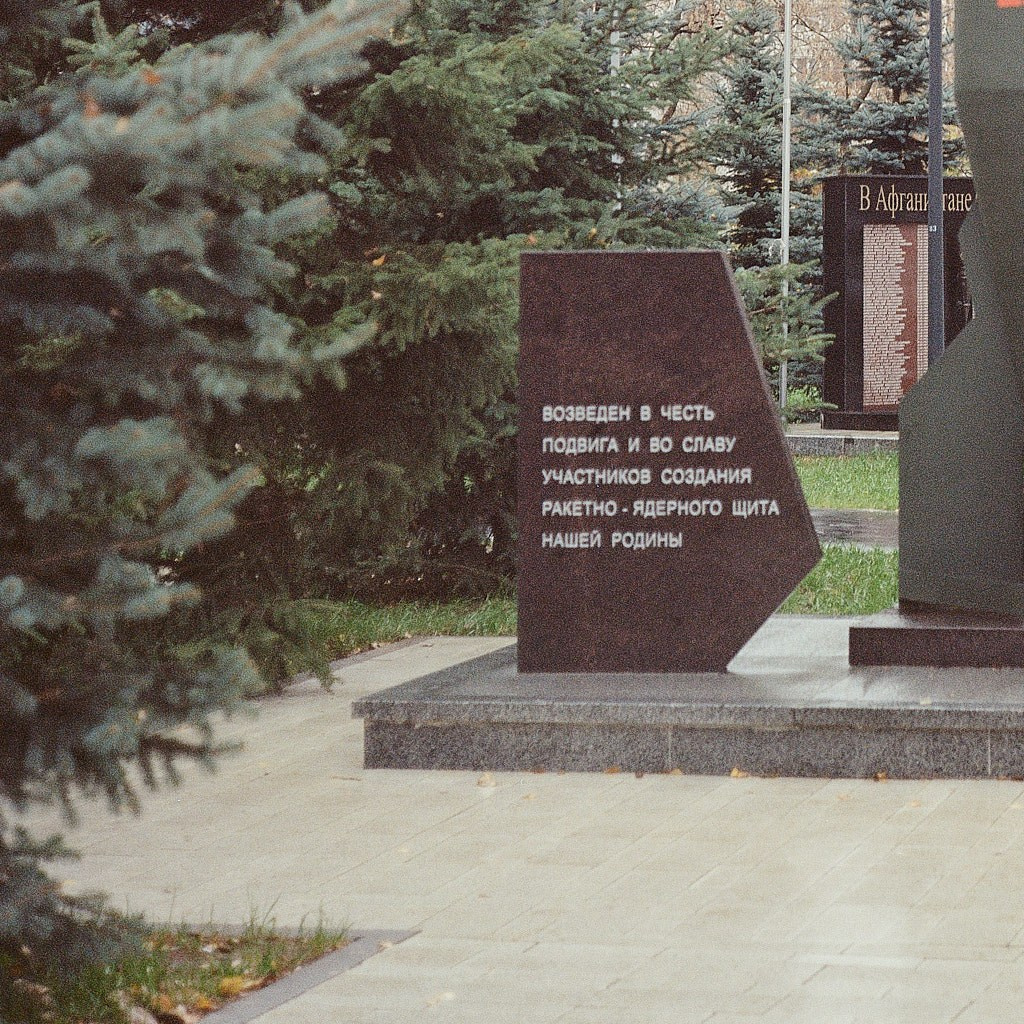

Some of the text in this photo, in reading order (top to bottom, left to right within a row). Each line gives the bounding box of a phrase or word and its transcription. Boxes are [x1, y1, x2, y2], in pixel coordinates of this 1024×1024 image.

[859, 184, 871, 211] В
[875, 183, 972, 219] Афгантане
[541, 404, 716, 424] ВОЗВЕДЕН В ЧЕСТЬ
[541, 436, 737, 456] ПОДВИГА И ВО СЛАВУ
[541, 467, 752, 487] УЧАСТНИКОВ СОЗДАНИЯ
[541, 499, 618, 517] РАКЕТНО
[632, 499, 723, 519] ЯДЕРНОГО
[732, 499, 780, 519] ЩИТА
[541, 529, 683, 550] НАШЕЙ РОДИНЫ
